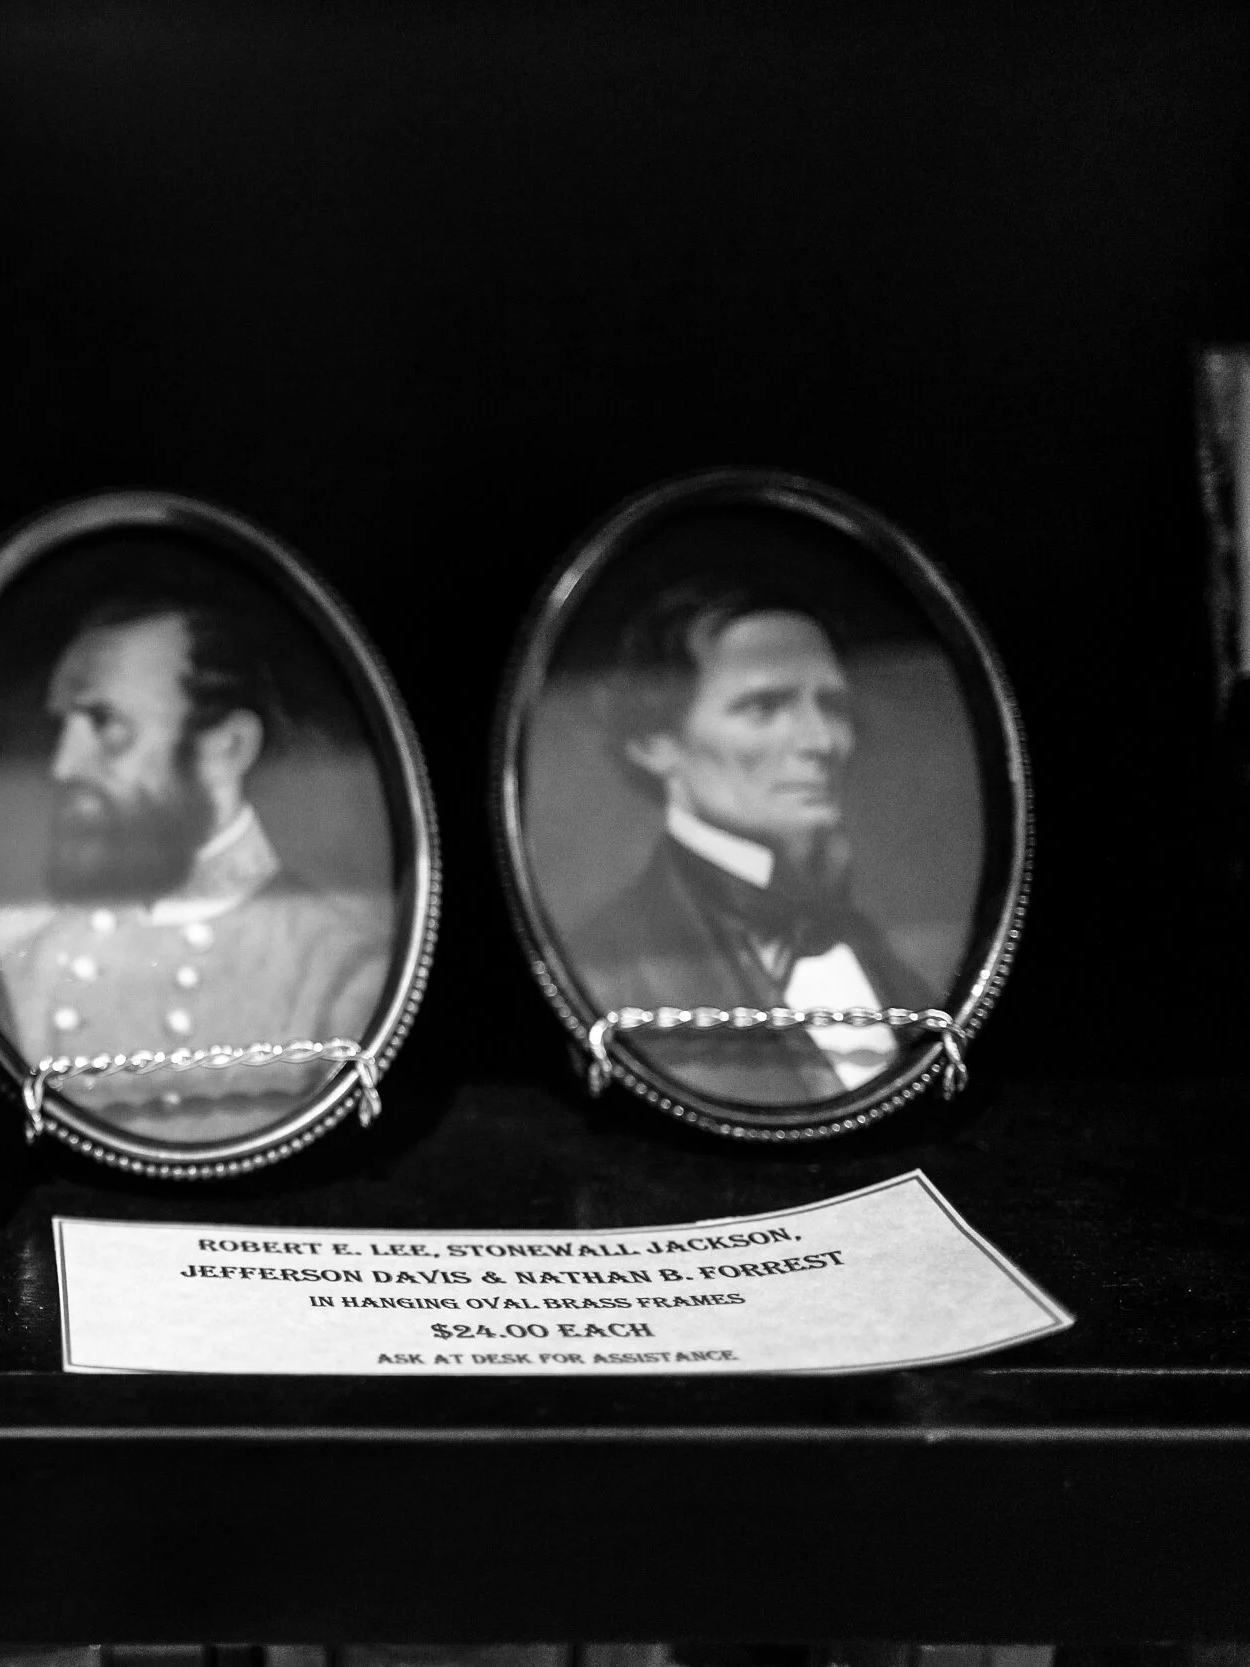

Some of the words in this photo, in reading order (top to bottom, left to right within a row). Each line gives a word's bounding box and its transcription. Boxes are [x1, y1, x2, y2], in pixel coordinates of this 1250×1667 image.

[198, 1237, 322, 1256] ROBERT
[332, 1242, 362, 1256] E.
[370, 1243, 441, 1259] LEE,
[446, 1241, 641, 1258] STONEWALL
[642, 1227, 803, 1255] JACKSON,
[180, 1264, 364, 1283] JEFFERSON
[371, 1269, 473, 1285] DAVIS
[481, 1269, 507, 1285] &
[514, 1269, 653, 1285] NATHAN
[657, 1267, 695, 1283] B.
[698, 1249, 845, 1281] FORREST
[308, 1295, 335, 1308] IN
[341, 1296, 462, 1310] HANGING
[465, 1296, 540, 1310] OVAL
[543, 1296, 634, 1310] BRASS
[635, 1292, 747, 1309] FRAMES
[430, 1322, 550, 1341] $24.00
[556, 1321, 656, 1339] EACH
[376, 1352, 426, 1366] ASK
[432, 1352, 464, 1366] AT
[470, 1352, 533, 1366] DESK
[538, 1352, 587, 1366] FOR
[592, 1349, 741, 1366] ASSISTANCE
